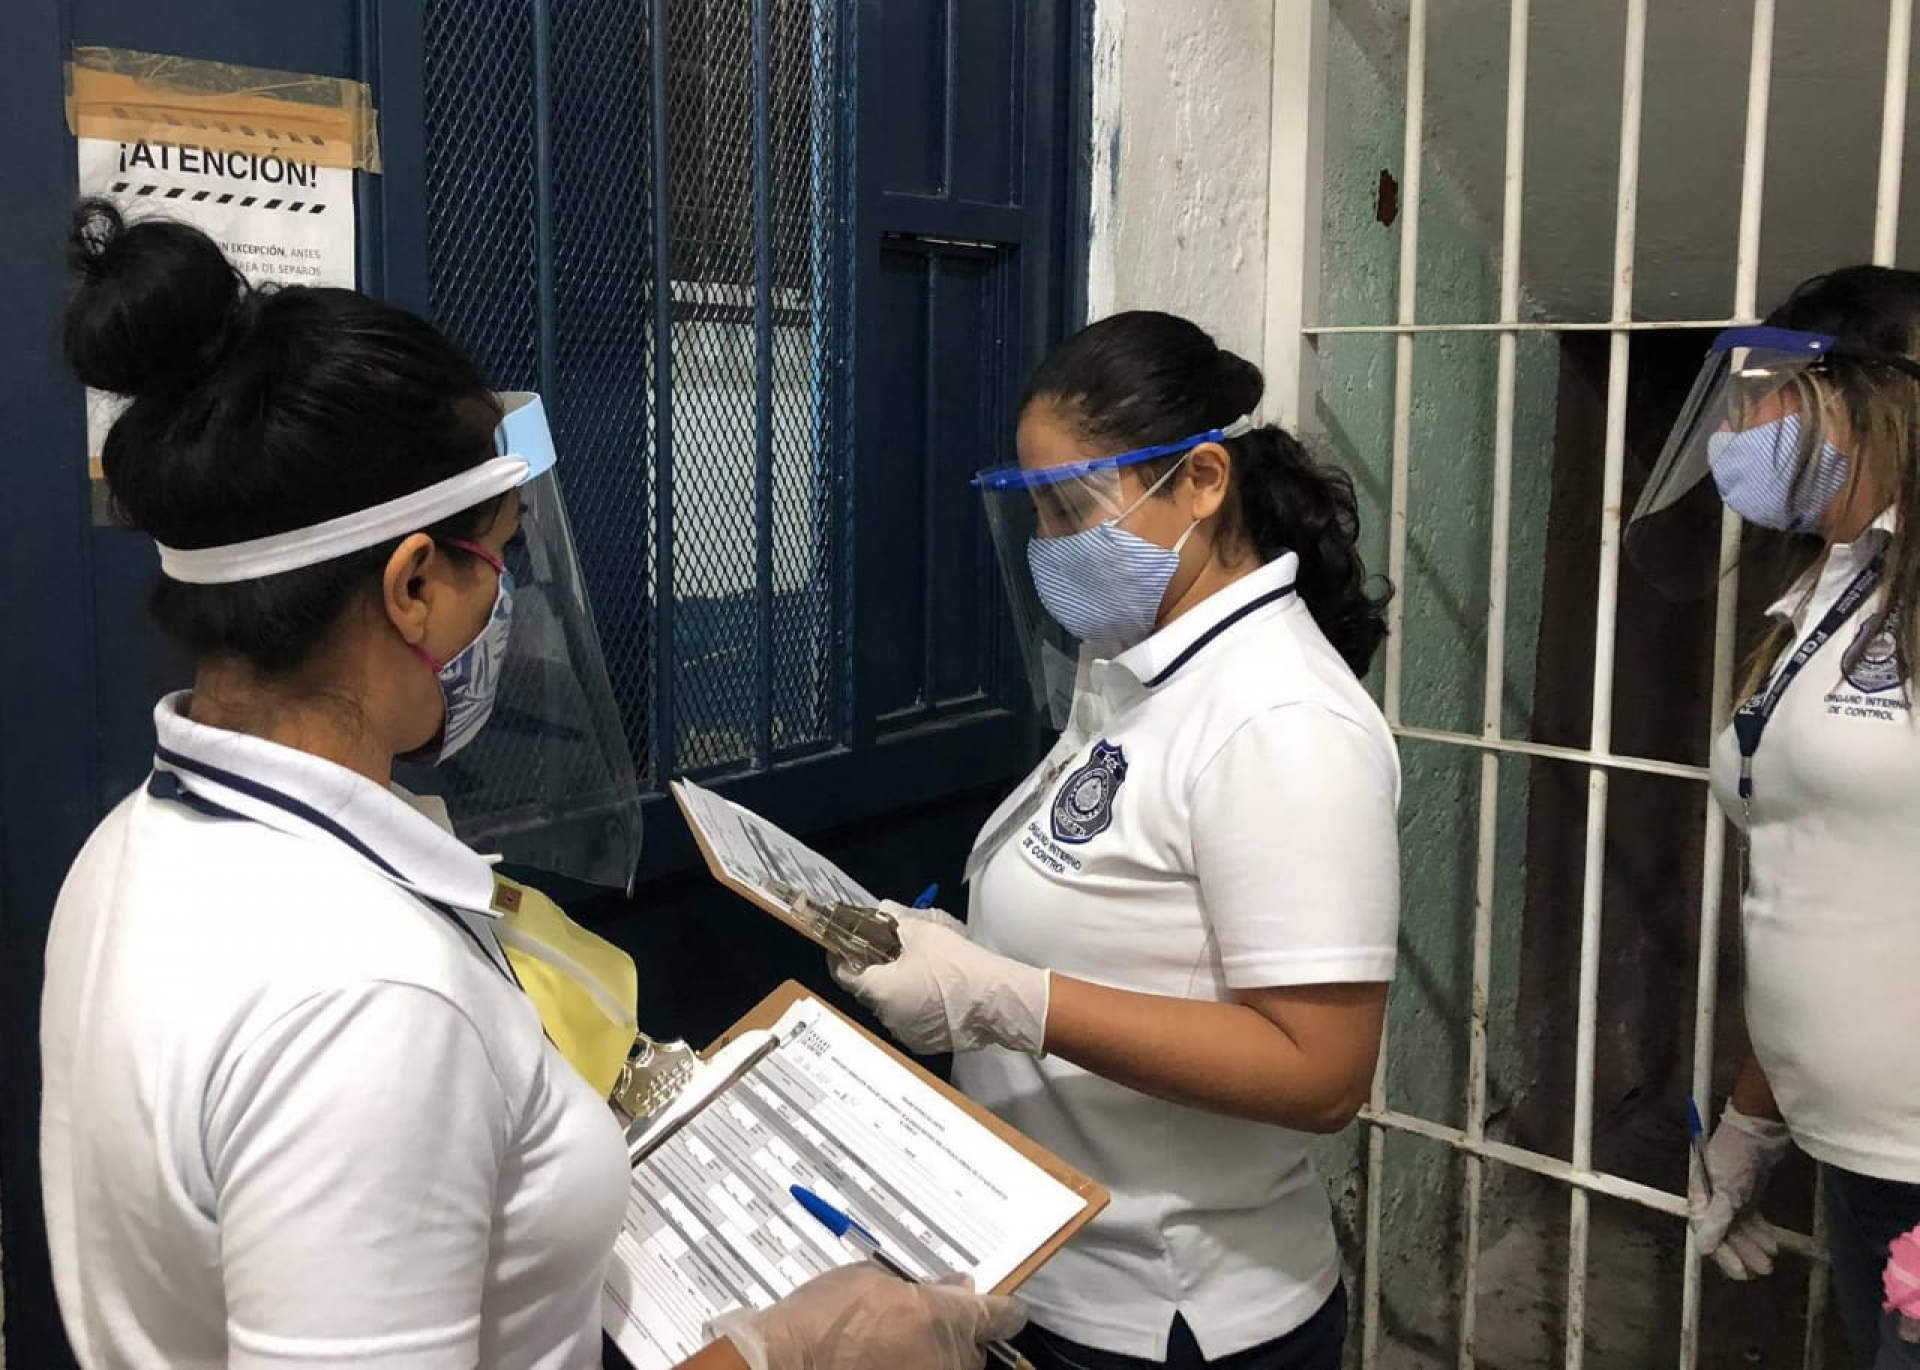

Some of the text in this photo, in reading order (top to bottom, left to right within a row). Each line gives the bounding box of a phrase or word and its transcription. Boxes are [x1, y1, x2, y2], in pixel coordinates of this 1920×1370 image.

[119, 138, 318, 188] ¡ATENCIÓN!
[231, 242, 287, 258] EXCEPCIÓN,
[291, 248, 321, 259] ANTES
[262, 263, 274, 274] DE
[278, 263, 321, 277] SEPAROS
[1844, 706, 1894, 721] CONTROL
[1031, 845, 1065, 875] CONTROL
